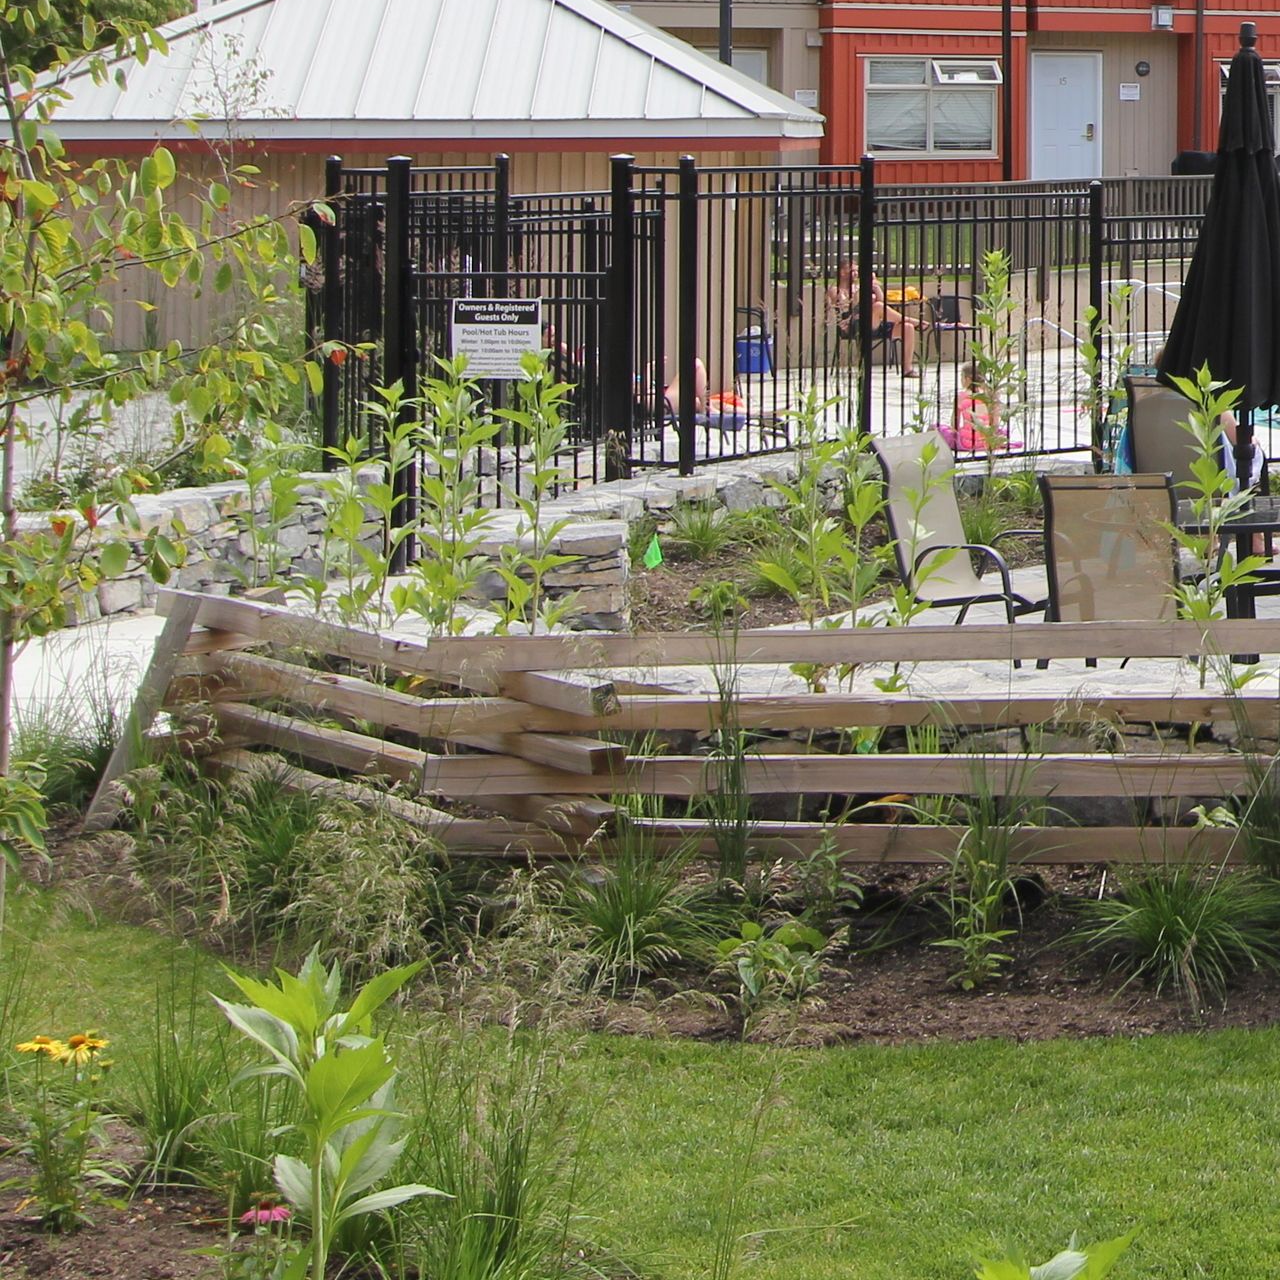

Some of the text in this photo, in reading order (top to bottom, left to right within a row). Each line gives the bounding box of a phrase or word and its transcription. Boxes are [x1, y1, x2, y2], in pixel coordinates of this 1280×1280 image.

[458, 303, 535, 313] Owners & Registered
[474, 313, 520, 323] Guests Only
[462, 328, 493, 336] Pool/Hot
